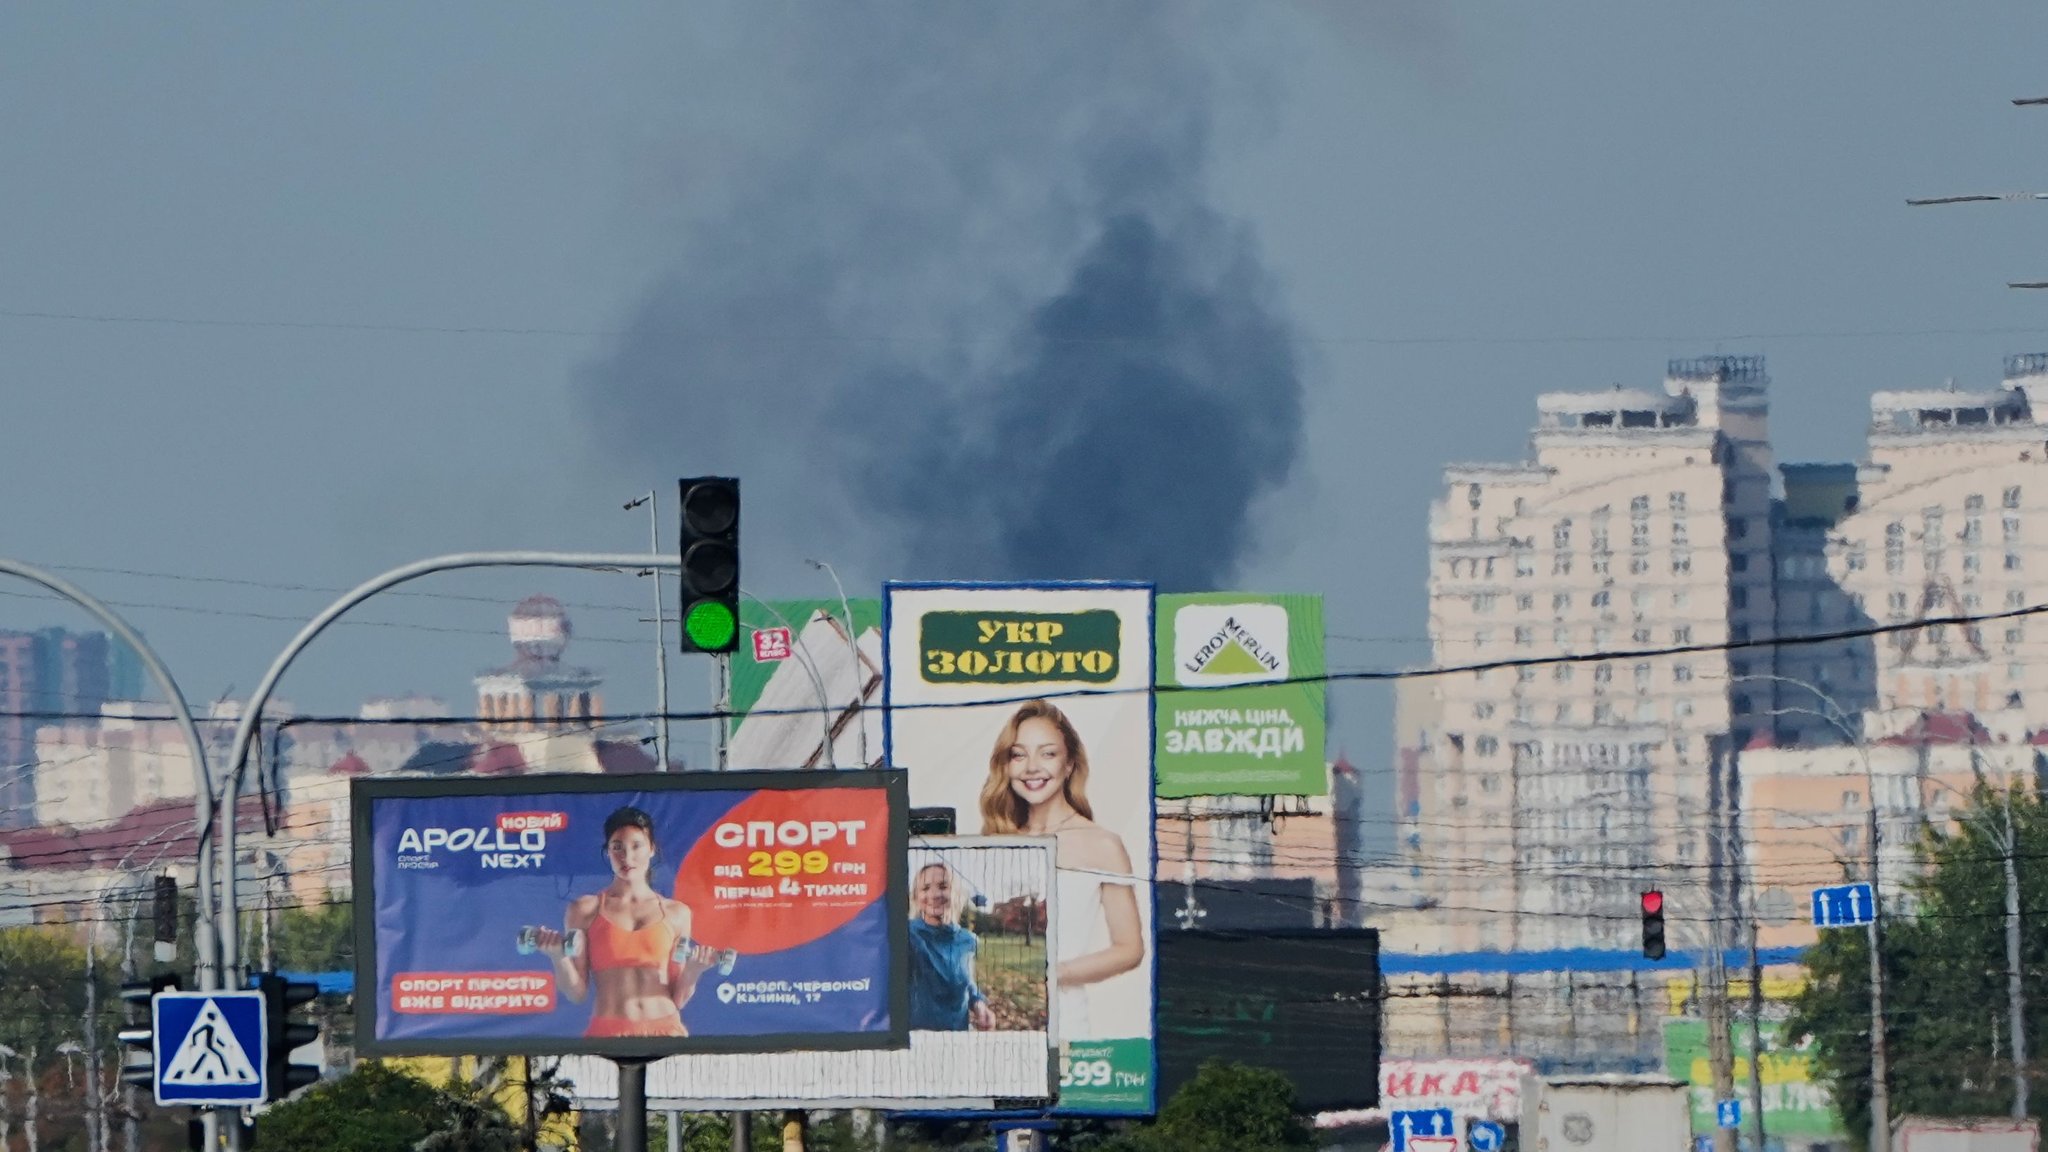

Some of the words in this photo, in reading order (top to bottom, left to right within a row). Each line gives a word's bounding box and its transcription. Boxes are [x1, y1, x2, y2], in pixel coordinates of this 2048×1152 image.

[758, 631, 786, 650] 32
[977, 619, 1064, 646] УКР
[1185, 628, 1229, 673] LEROY
[1225, 616, 1280, 671] MERLIN
[926, 649, 1114, 676] ЗОЛОТО
[1174, 709, 1241, 727] НИЖЧА
[1245, 708, 1296, 727] ЦІНА,
[1164, 725, 1305, 759] ЗАВЖДИ
[501, 812, 562, 830] НОВИЙ
[714, 820, 867, 848] СПОРТ
[397, 827, 547, 853] APOLLO
[481, 853, 546, 869] NEXT
[714, 864, 743, 877] ВІД
[748, 850, 829, 877] 299
[833, 862, 866, 875] ГРН
[714, 884, 774, 899] ПЕРШІ
[779, 876, 802, 896] 4
[803, 882, 868, 897] ТИЖНІ
[399, 995, 444, 1009] ВЖЕ
[450, 994, 549, 1010] ВІДКРИТО
